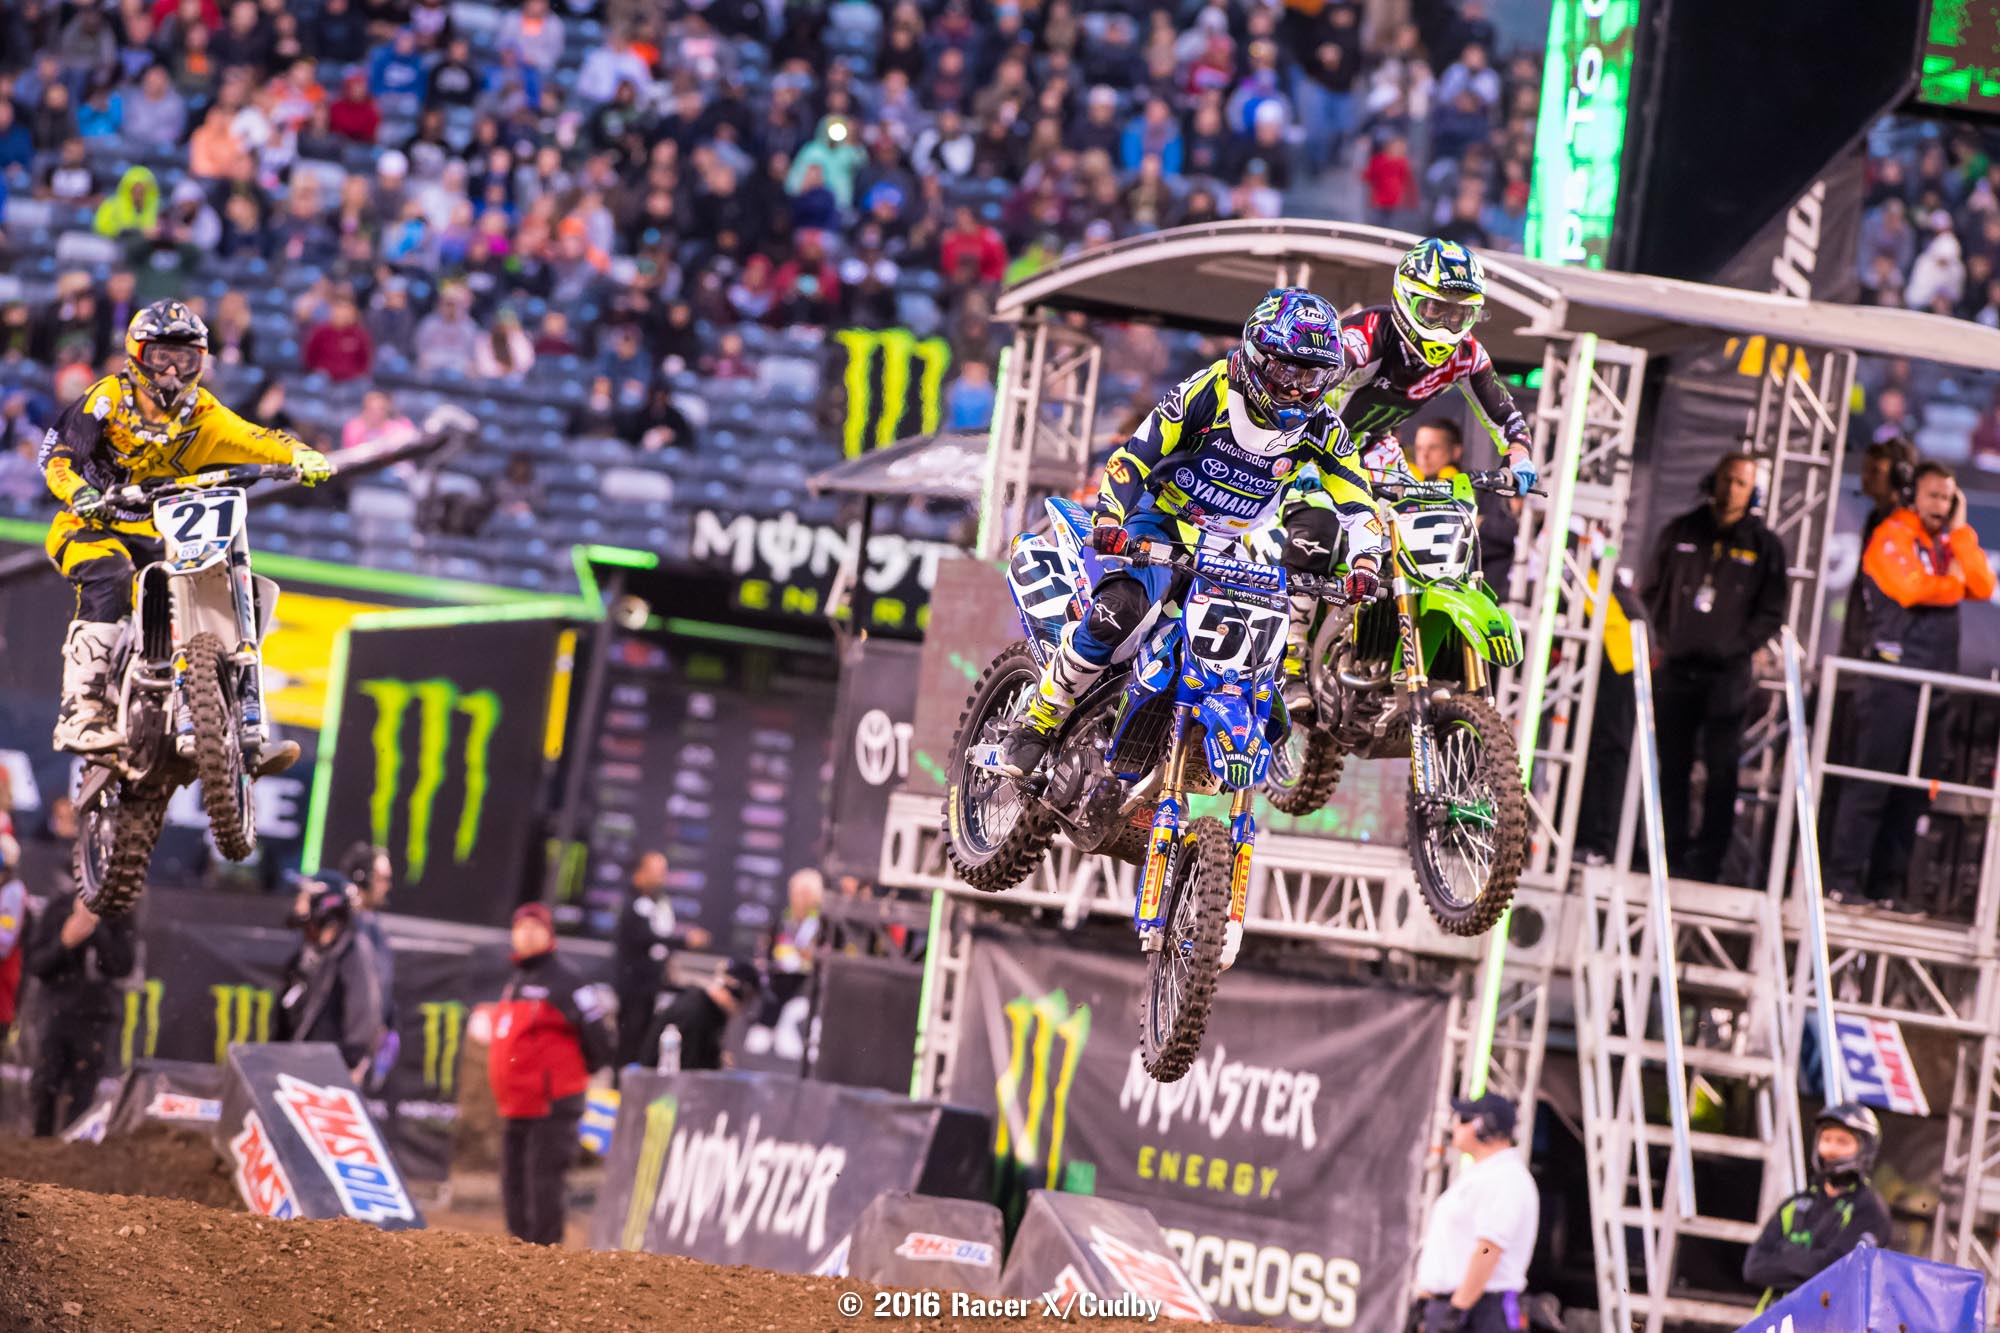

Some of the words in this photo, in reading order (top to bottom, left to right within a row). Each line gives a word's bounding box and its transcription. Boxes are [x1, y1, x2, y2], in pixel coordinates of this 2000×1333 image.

[1299, 309, 1326, 321] Arai
[1312, 347, 1341, 359] TOYOTA
[1211, 437, 1272, 470] Autotrader
[1228, 479, 1244, 489] Let's
[1244, 485, 1255, 494] Go
[1232, 469, 1278, 490] TOYOTA
[1193, 479, 1261, 518] YAMAHA
[171, 500, 236, 544] 21
[1409, 514, 1472, 565] 3
[1010, 550, 1074, 610] 51
[1202, 555, 1280, 575] RENTHAL
[1234, 591, 1270, 604] MONSTER
[1191, 602, 1284, 668] 51
[1226, 753, 1253, 765] YAMAHA
[1119, 1044, 1321, 1151] MONSTER
[653, 1110, 846, 1255] MONSTER
[1137, 1146, 1279, 1198] ENERGY
